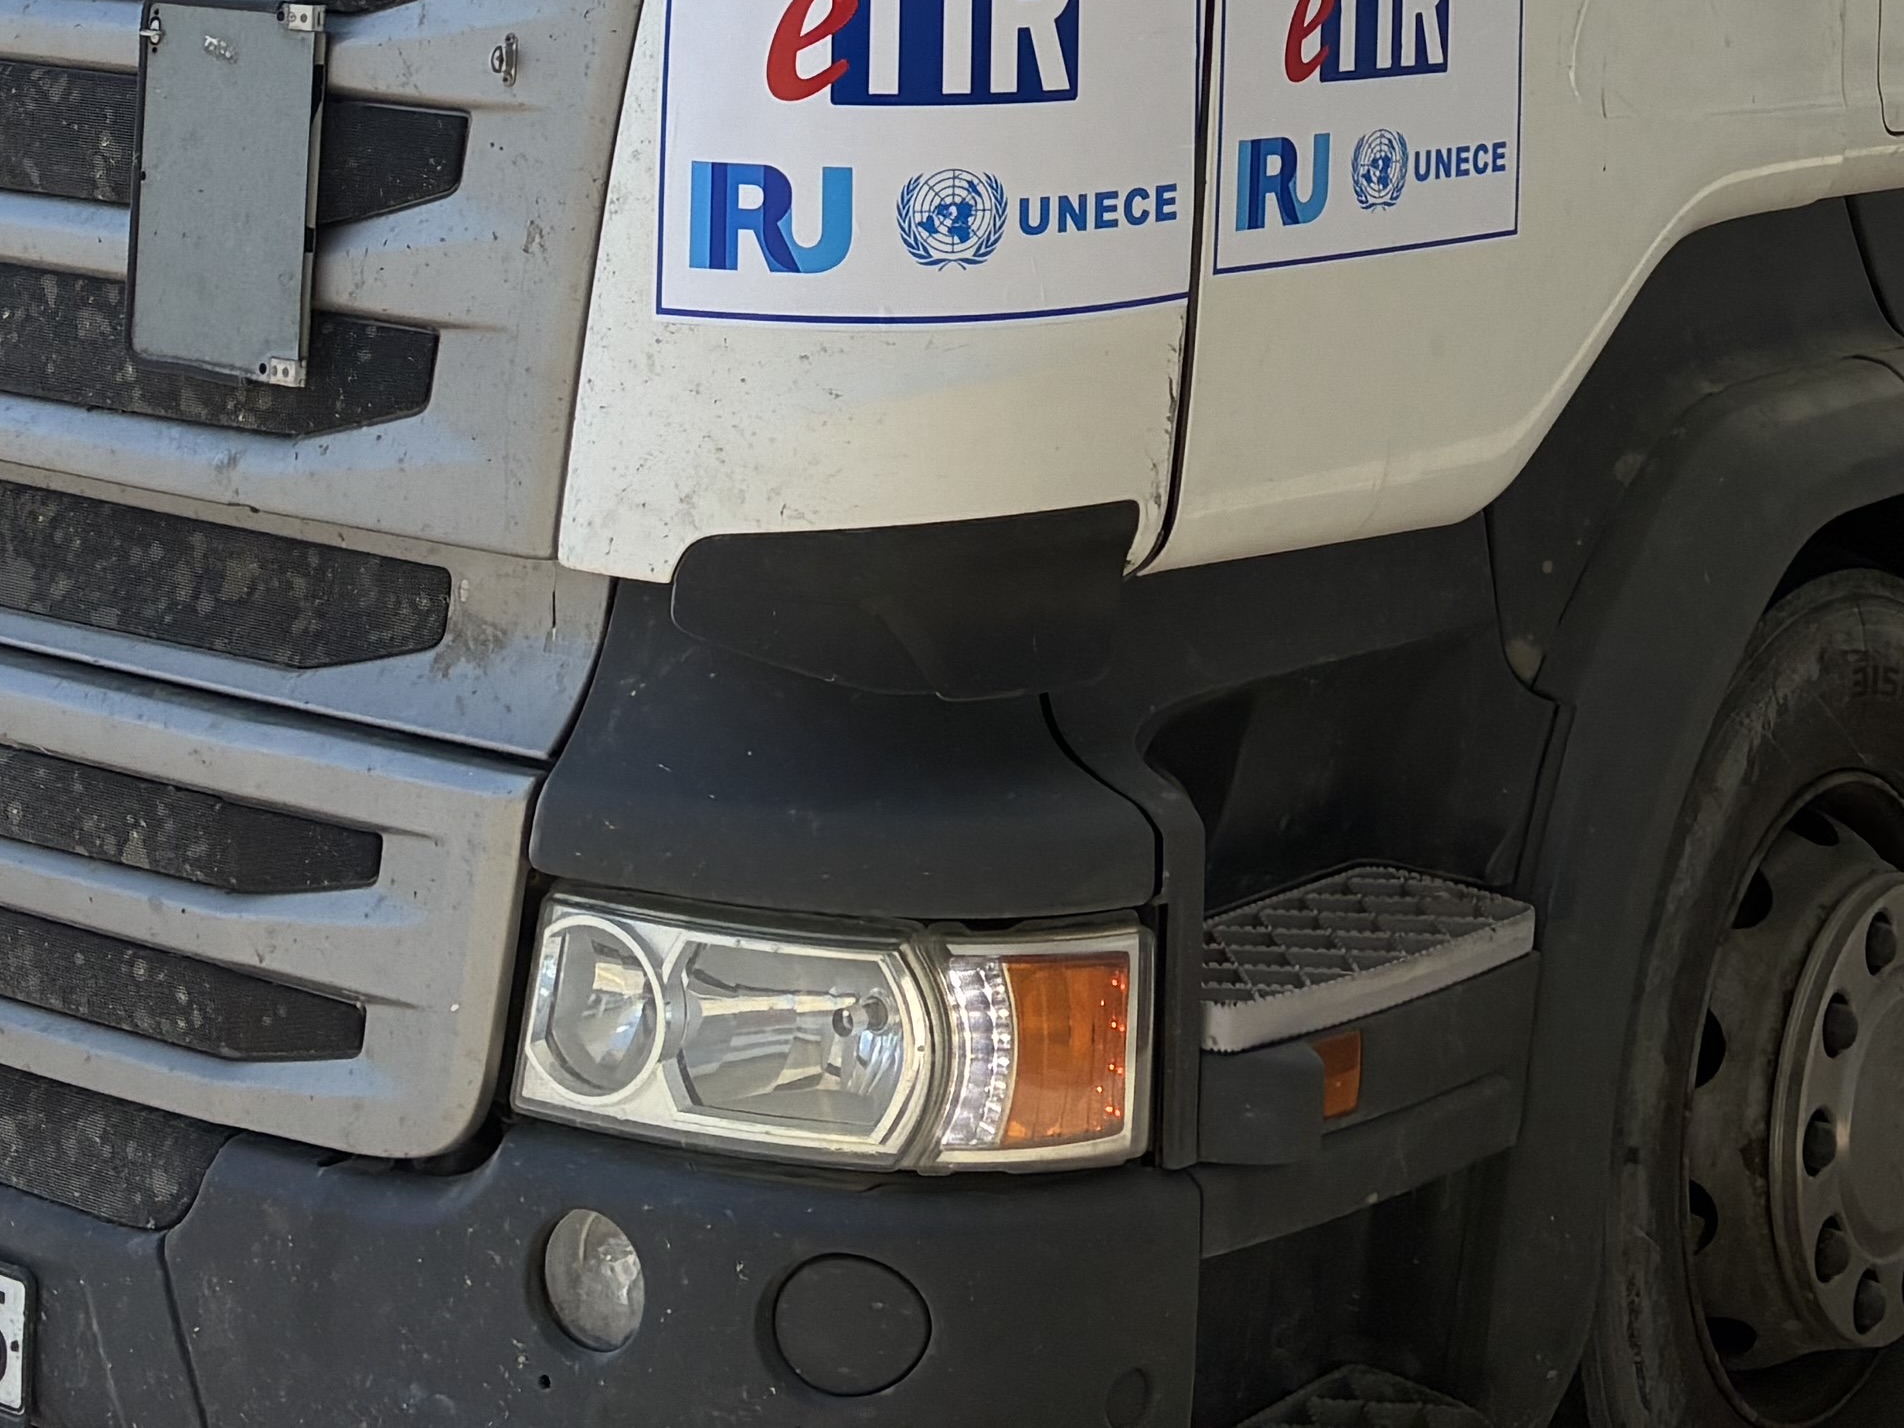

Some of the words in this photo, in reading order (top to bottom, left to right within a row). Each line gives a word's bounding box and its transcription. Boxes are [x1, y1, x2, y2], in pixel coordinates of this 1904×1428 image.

[689, 160, 853, 275] IRU
[1017, 182, 1179, 237] UNECE
[1235, 131, 1331, 232] IRU
[1412, 140, 1508, 183] UNECE
